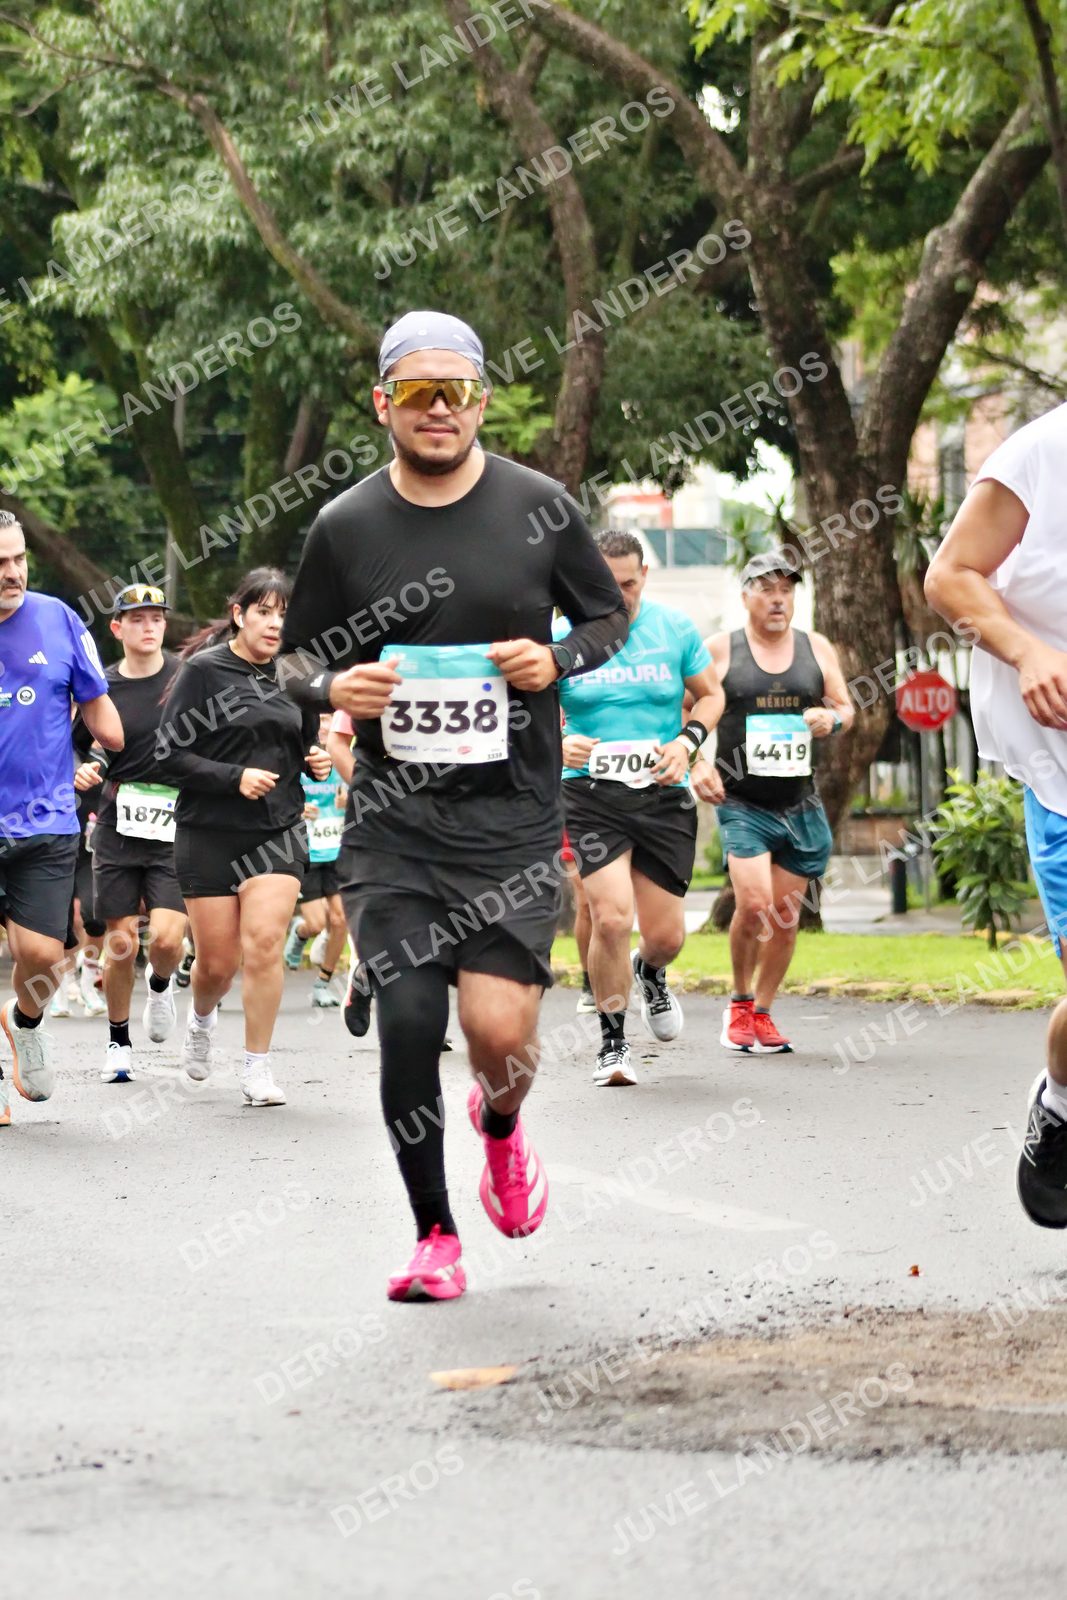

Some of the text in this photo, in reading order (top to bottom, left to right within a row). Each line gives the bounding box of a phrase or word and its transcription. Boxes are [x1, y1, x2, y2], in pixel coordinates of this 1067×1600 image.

[756, 694, 800, 708] MÉXICO
[900, 688, 950, 713] ALTO
[389, 699, 498, 734] 3338
[753, 743, 807, 761] 4419
[595, 753, 656, 774] 5704
[122, 805, 175, 826] 1877
